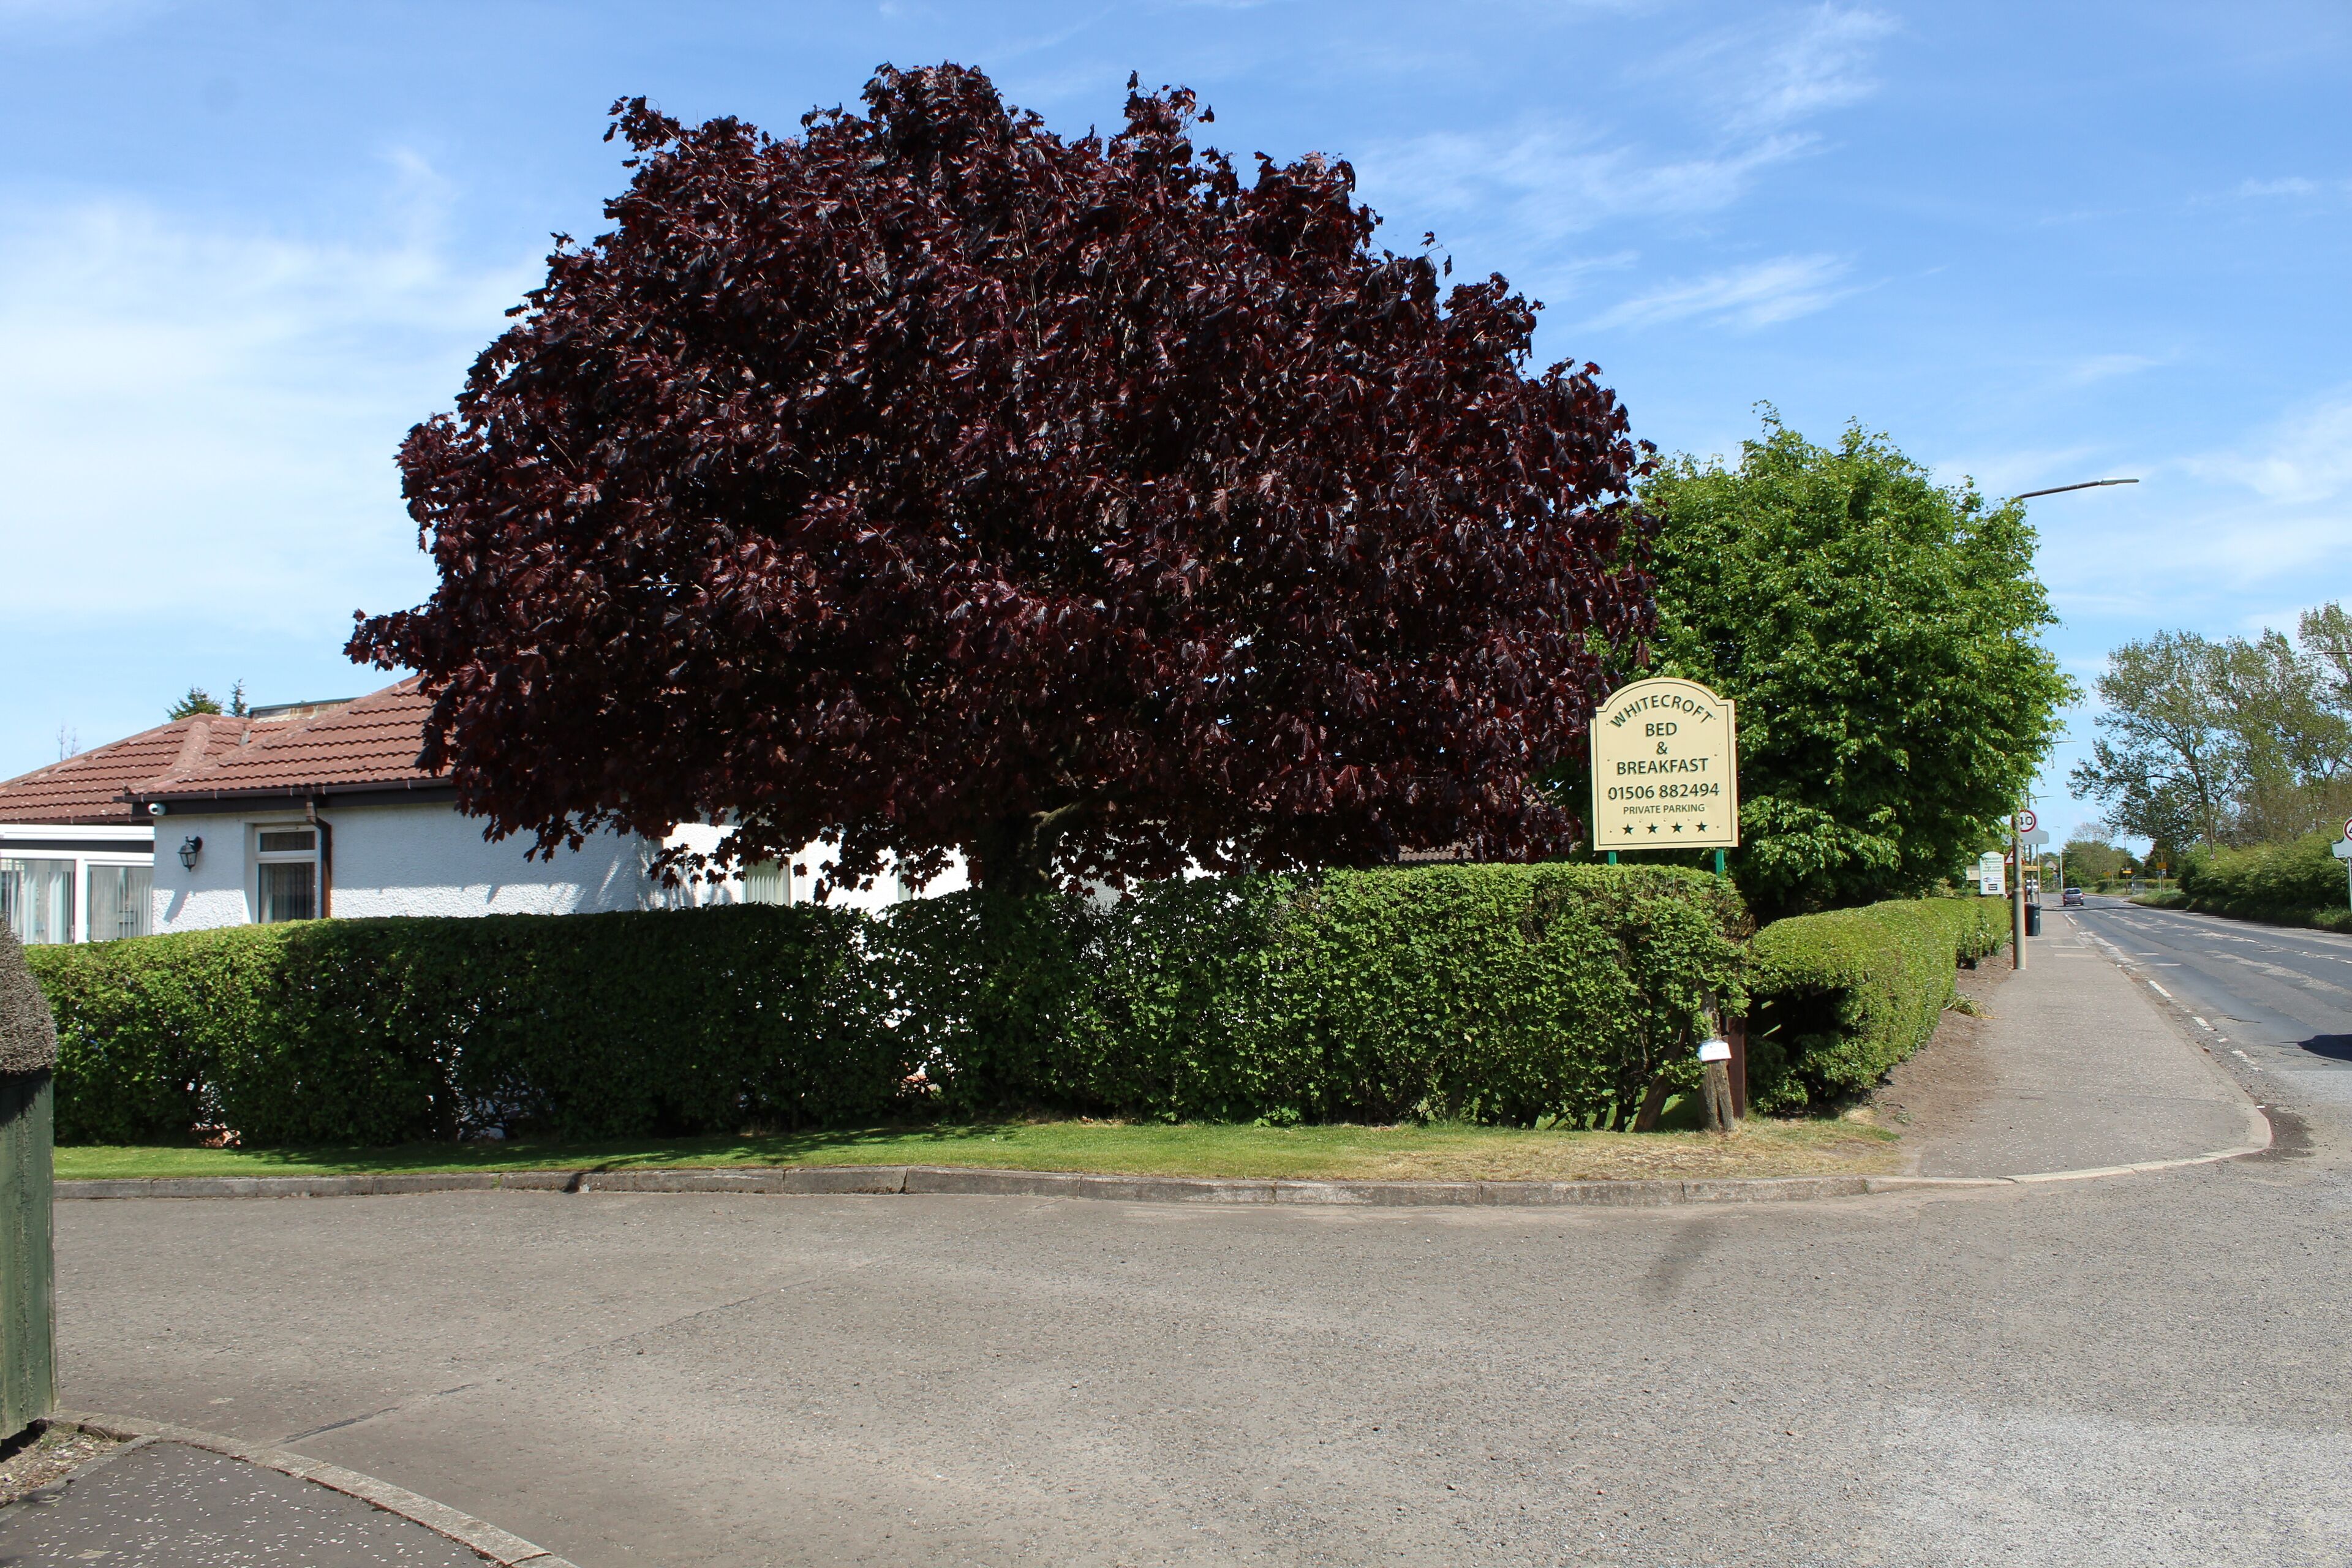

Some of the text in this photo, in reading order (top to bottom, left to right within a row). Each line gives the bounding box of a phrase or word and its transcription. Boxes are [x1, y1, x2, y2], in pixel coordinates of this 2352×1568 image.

[1610, 694, 1714, 728] WHITECROFT
[1645, 722, 1678, 737] BED
[1656, 741, 1668, 755] &
[1616, 758, 1709, 775] BREAKFAST
[1608, 783, 1720, 801] 01506 882494
[1623, 804, 1705, 815] PRIVATE PARKING
